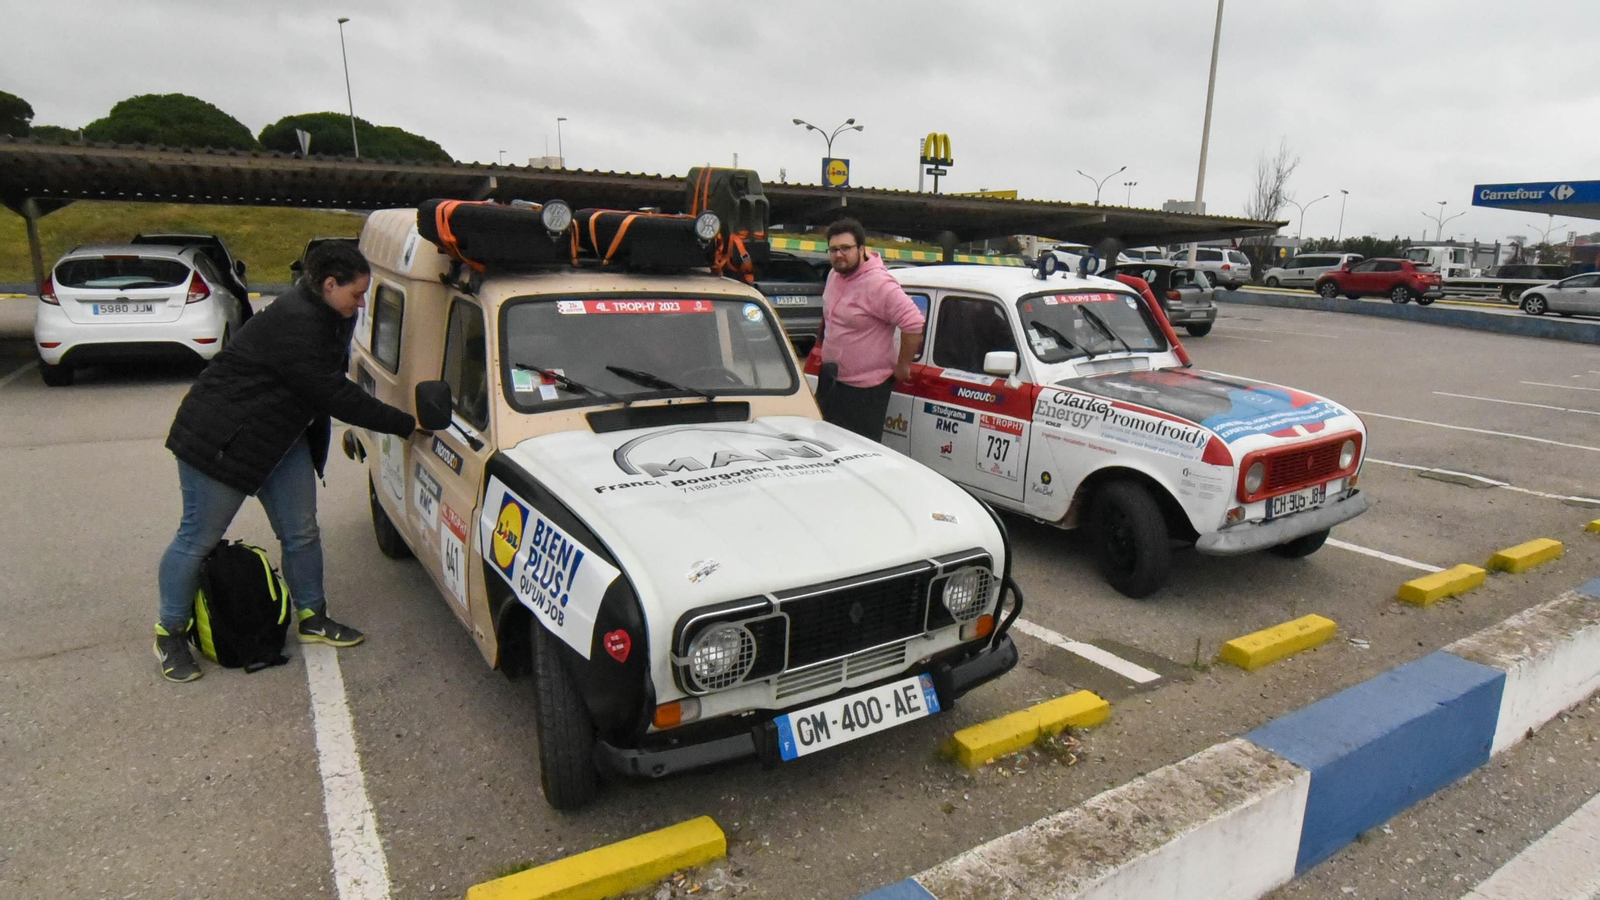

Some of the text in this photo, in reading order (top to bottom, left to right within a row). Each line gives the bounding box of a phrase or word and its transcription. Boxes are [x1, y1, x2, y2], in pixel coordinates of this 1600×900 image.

[1480, 188, 1545, 200] Carrefour
[100, 304, 153, 313] 5980 JJM
[596, 301, 680, 311] 4L TROPHY 2023
[957, 387, 996, 403] Norauto
[1053, 391, 1108, 415] Clarke
[932, 405, 967, 420] Studyrama
[980, 413, 990, 424] 4L
[1035, 399, 1094, 429] Energy
[936, 418, 959, 434] RMC
[1102, 408, 1200, 444] Promofroid
[435, 440, 459, 470] Norauto
[638, 444, 823, 478] MAN
[986, 434, 1010, 462] 737
[680, 481, 717, 493] 71880
[798, 468, 835, 477] ROYAL
[419, 488, 433, 516] RMC
[532, 518, 574, 571] BIEN
[446, 537, 459, 582] 641
[520, 574, 565, 627] QU'UN JOB
[796, 684, 921, 746] GM-400-AE
[925, 694, 938, 710] 71
